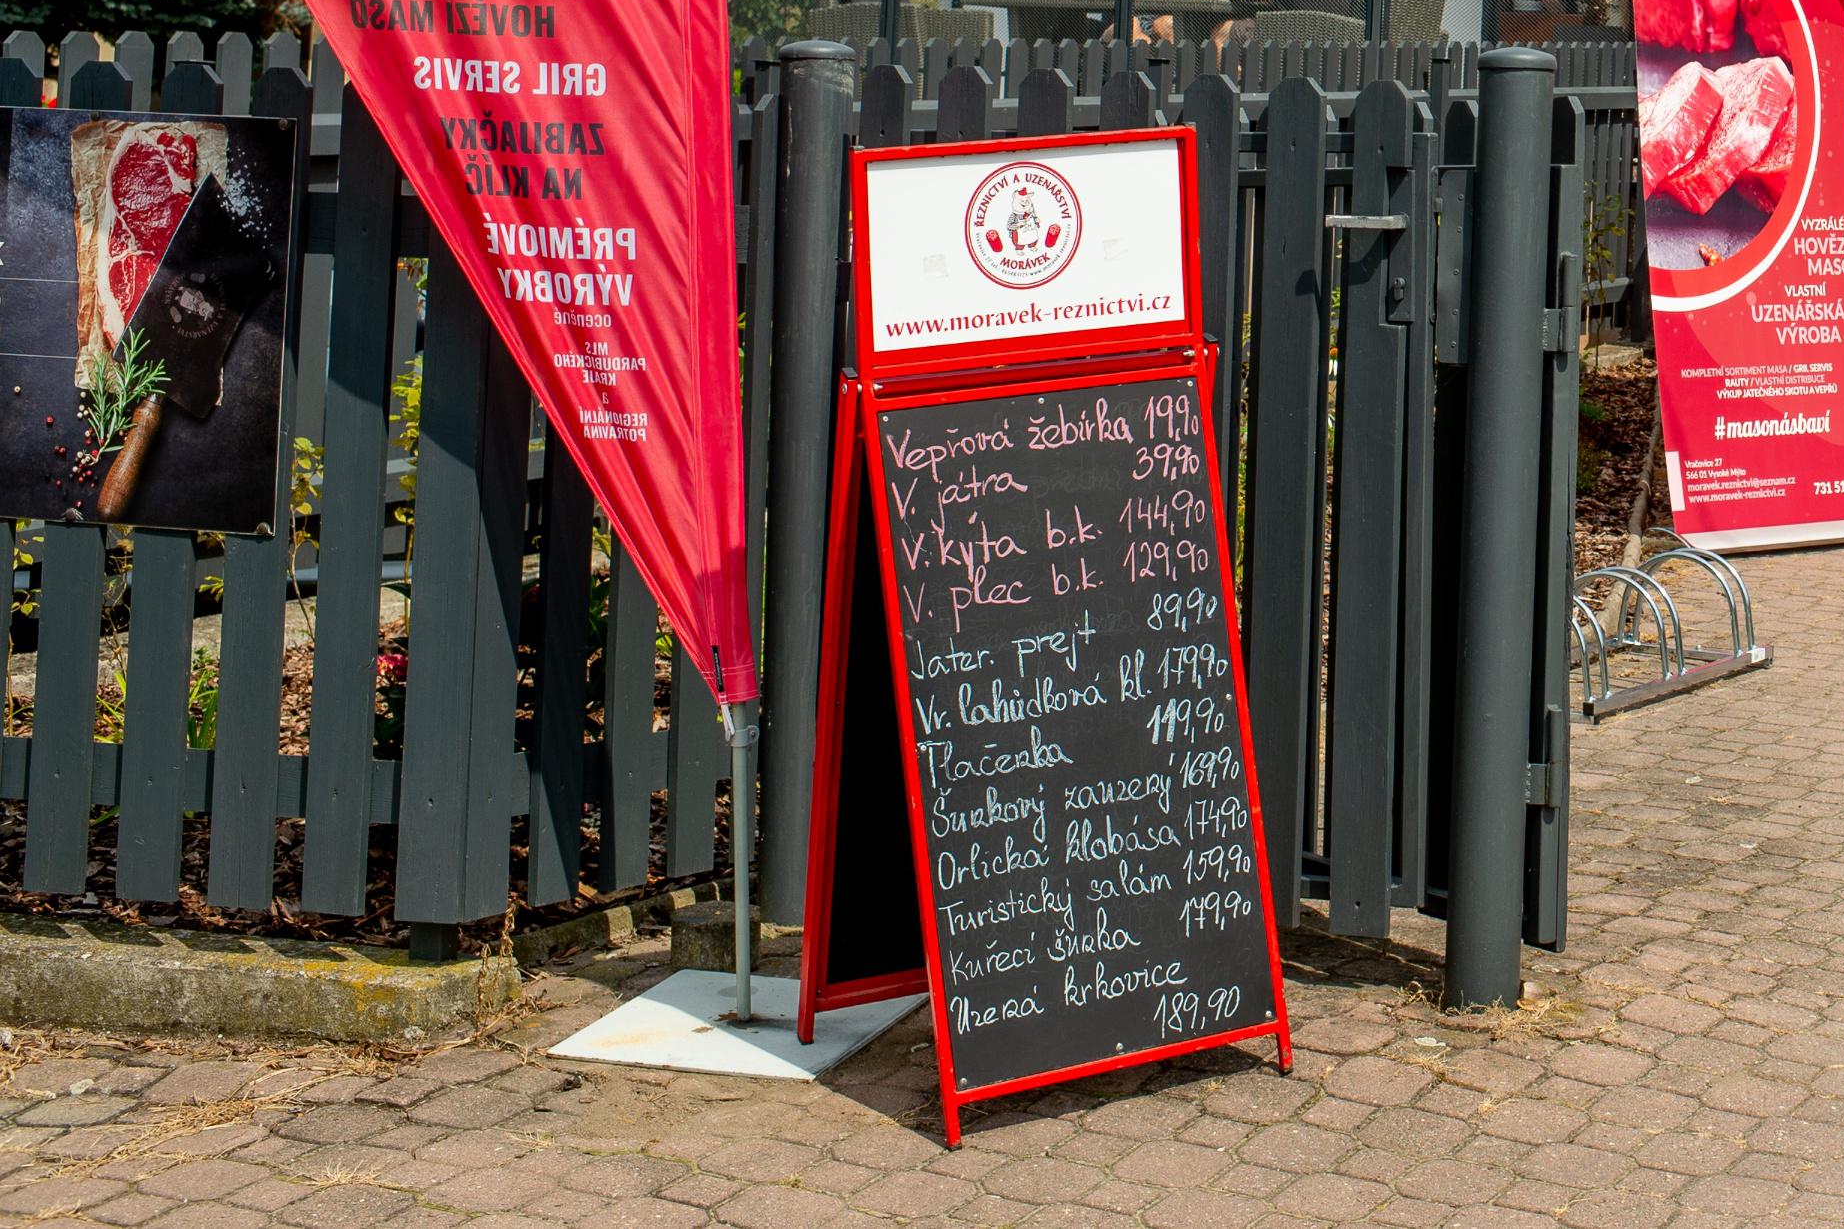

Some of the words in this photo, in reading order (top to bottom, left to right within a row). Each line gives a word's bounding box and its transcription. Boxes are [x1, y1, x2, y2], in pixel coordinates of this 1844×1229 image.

[974, 176, 1009, 227] ŘEZNICTVÍ
[1013, 173, 1020, 184] A
[1025, 173, 1072, 219] UZENÁŘSTVÍ
[1801, 216, 1844, 231] VYZRÁLÉ
[1000, 252, 1051, 270] MORÁVEK
[1784, 282, 1826, 297] VLASTNÍ
[886, 292, 1172, 338] www.moravek-reznictvi.cz
[1751, 299, 1844, 322] UZENÁŘSKÁ
[1776, 323, 1841, 345] VÝROBA
[1681, 366, 1724, 378] KOMPLETNÍ
[1725, 366, 1766, 376] SORTIMENT
[1767, 365, 1788, 374] MASA
[1793, 364, 1809, 372] GRIL
[1810, 363, 1833, 371] SERVIS
[1725, 377, 1749, 388] RAUTY
[1755, 375, 1785, 386] VLASTNÍ
[1786, 374, 1825, 385] DISTRIBUCE
[1716, 388, 1742, 400] VÝKUP
[1743, 385, 1784, 398] JATEČNÉHO
[1785, 385, 1809, 396] SKOTU
[1714, 409, 1831, 440] #masonásbaví
[1684, 459, 1714, 469] Vračovice
[1714, 458, 1723, 467] 27
[1687, 477, 1796, 492] moravek.reznictvi@seznam.cz
[1814, 481, 1832, 495] 731
[1688, 487, 1786, 504] www.moravek-reznictvi.cz
